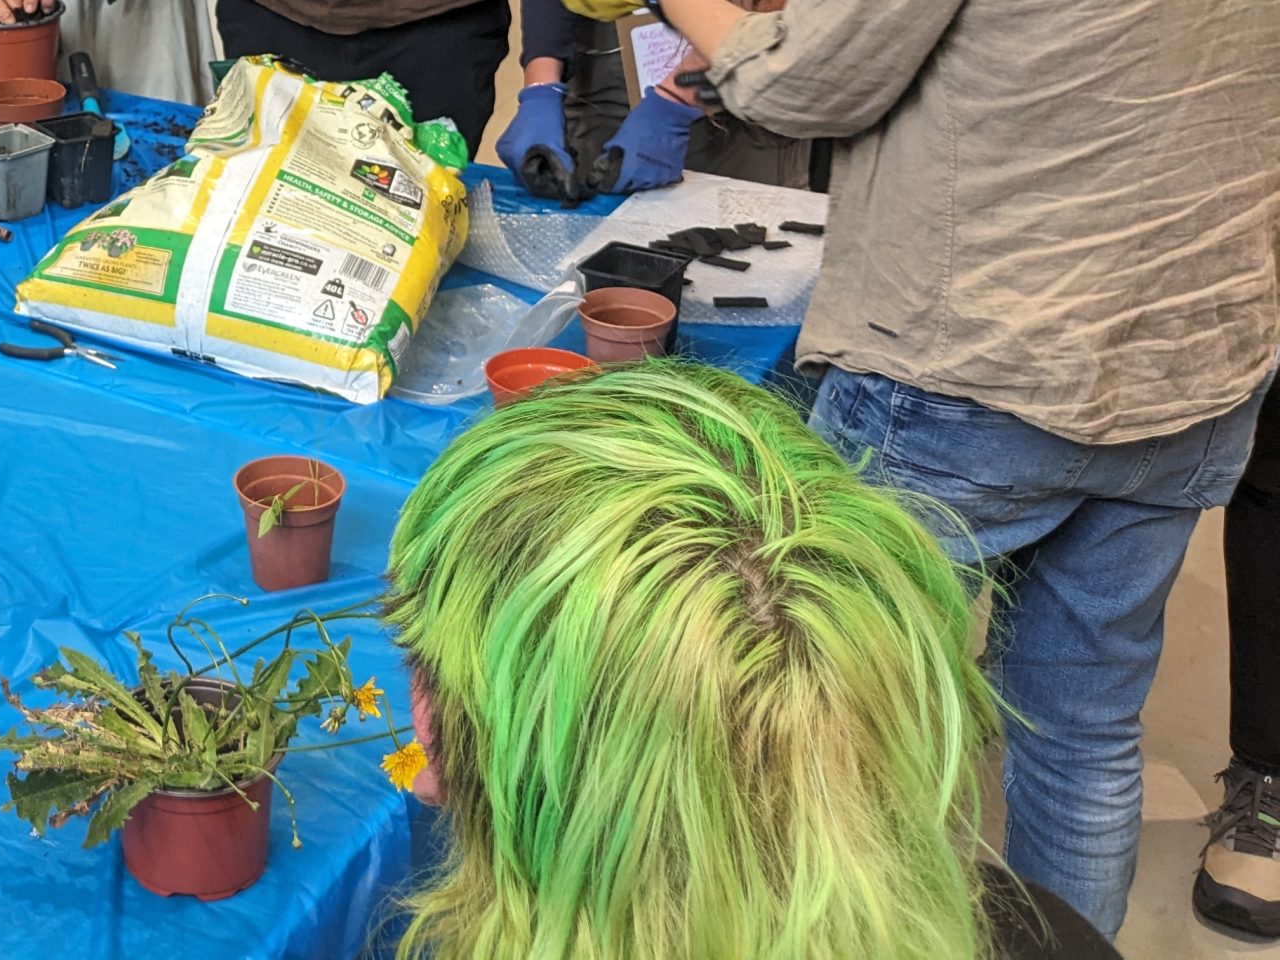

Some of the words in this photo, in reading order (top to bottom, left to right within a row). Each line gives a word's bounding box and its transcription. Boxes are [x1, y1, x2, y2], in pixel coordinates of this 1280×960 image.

[282, 173, 313, 192] HEALTH,
[314, 187, 341, 205] SAFETY
[341, 200, 349, 209] &
[349, 203, 385, 226] STORAGE
[384, 221, 411, 242] ADVICE
[78, 260, 100, 271] TWICE
[101, 264, 110, 272] AS
[111, 265, 127, 275] BIG!
